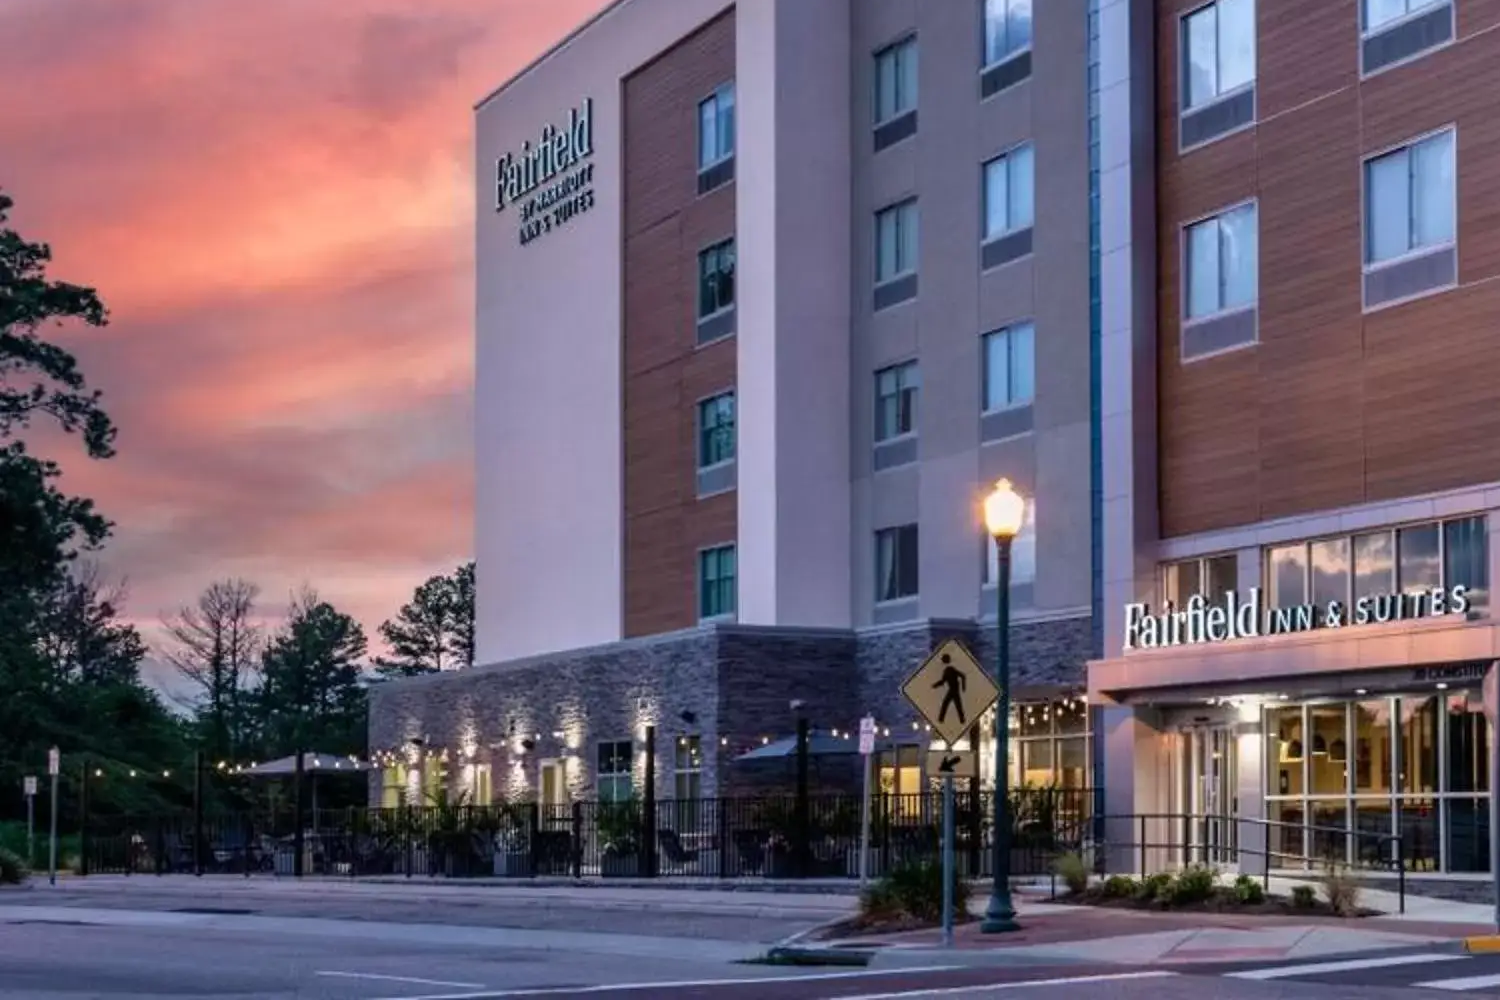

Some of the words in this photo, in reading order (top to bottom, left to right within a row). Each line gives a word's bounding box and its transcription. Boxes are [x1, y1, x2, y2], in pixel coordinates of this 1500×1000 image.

[495, 97, 593, 212] Fairfield
[1122, 586, 1260, 650] Fairfield
[1266, 604, 1313, 634] INN
[1325, 600, 1341, 628] &
[1355, 584, 1466, 624] SUITES
